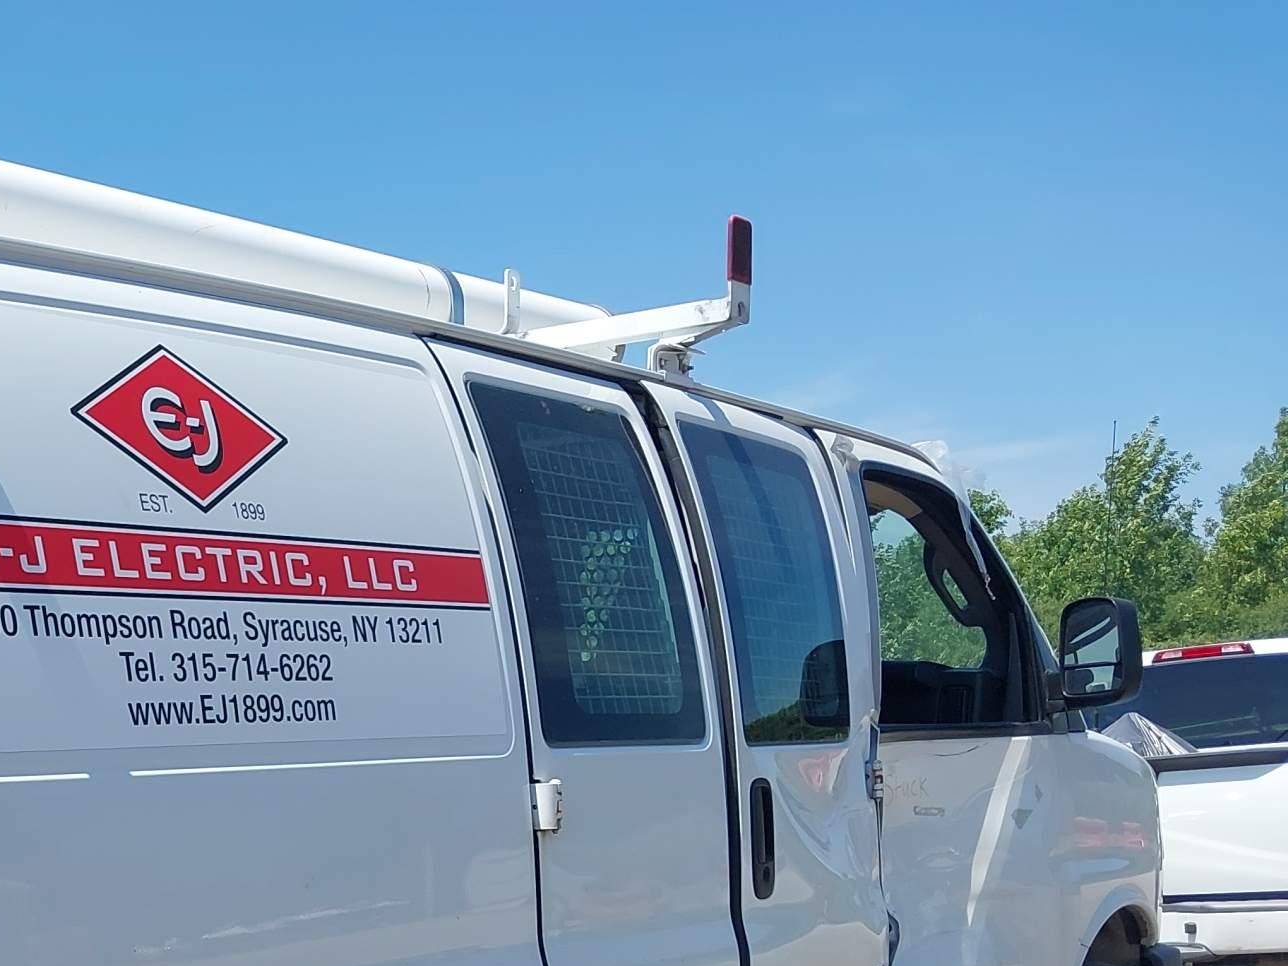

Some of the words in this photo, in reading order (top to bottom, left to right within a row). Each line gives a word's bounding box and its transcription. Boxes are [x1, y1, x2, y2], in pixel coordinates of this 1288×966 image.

[142, 387, 222, 473] E-J
[139, 493, 173, 513] EST.
[231, 502, 265, 520] 1899
[72, 538, 327, 595] ELECTRIC,
[343, 556, 418, 592] LLC
[23, 605, 162, 645] Thompson
[170, 610, 239, 646] Road,
[242, 611, 348, 647] Syracuse,
[352, 615, 378, 643] NY
[385, 617, 443, 644] 13211
[119, 652, 165, 683] Tel.
[171, 652, 334, 682] 315-714-6262
[128, 694, 337, 726] www.EJ1899.com
